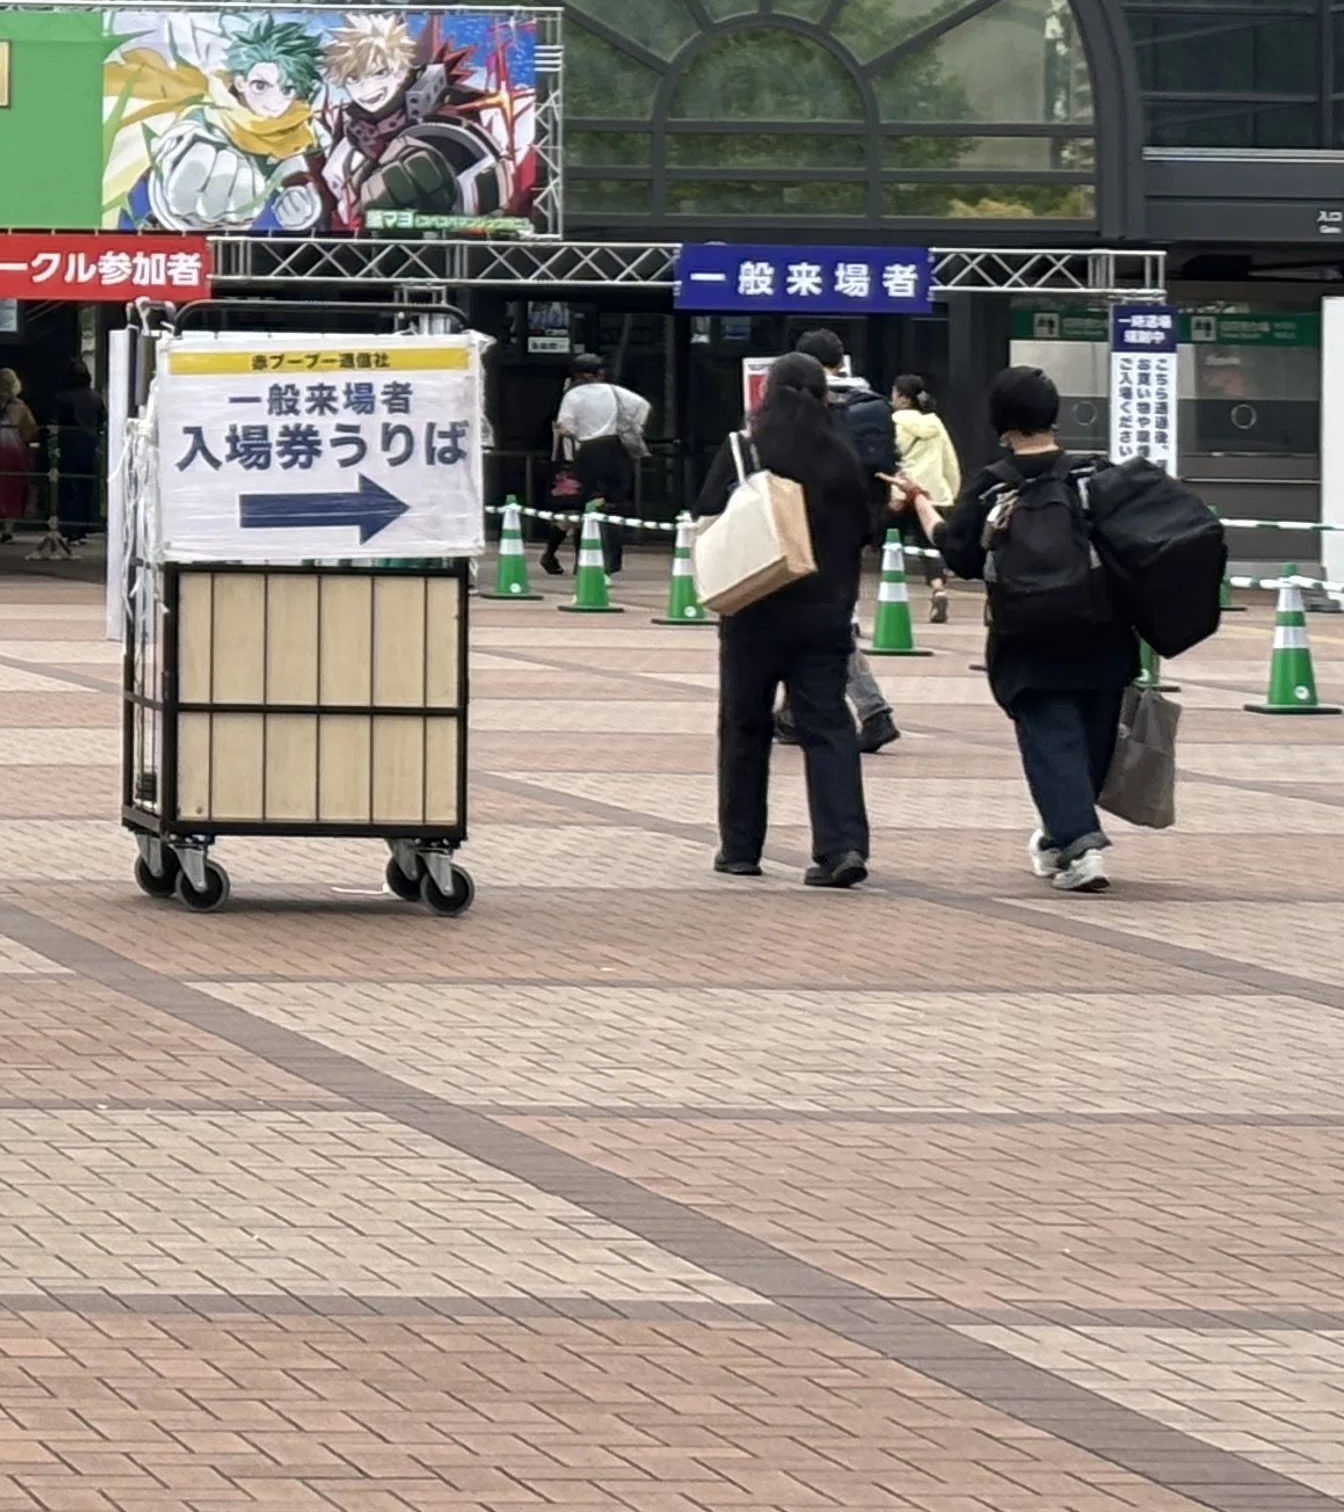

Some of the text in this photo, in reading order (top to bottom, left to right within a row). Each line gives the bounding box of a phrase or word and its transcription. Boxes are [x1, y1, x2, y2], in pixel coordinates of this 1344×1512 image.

[689, 260, 919, 297] 一般来場者
[252, 353, 391, 370] 赤ブーブー通信社
[228, 381, 415, 416] 一般来場者
[175, 421, 469, 472] 入場券うりば
